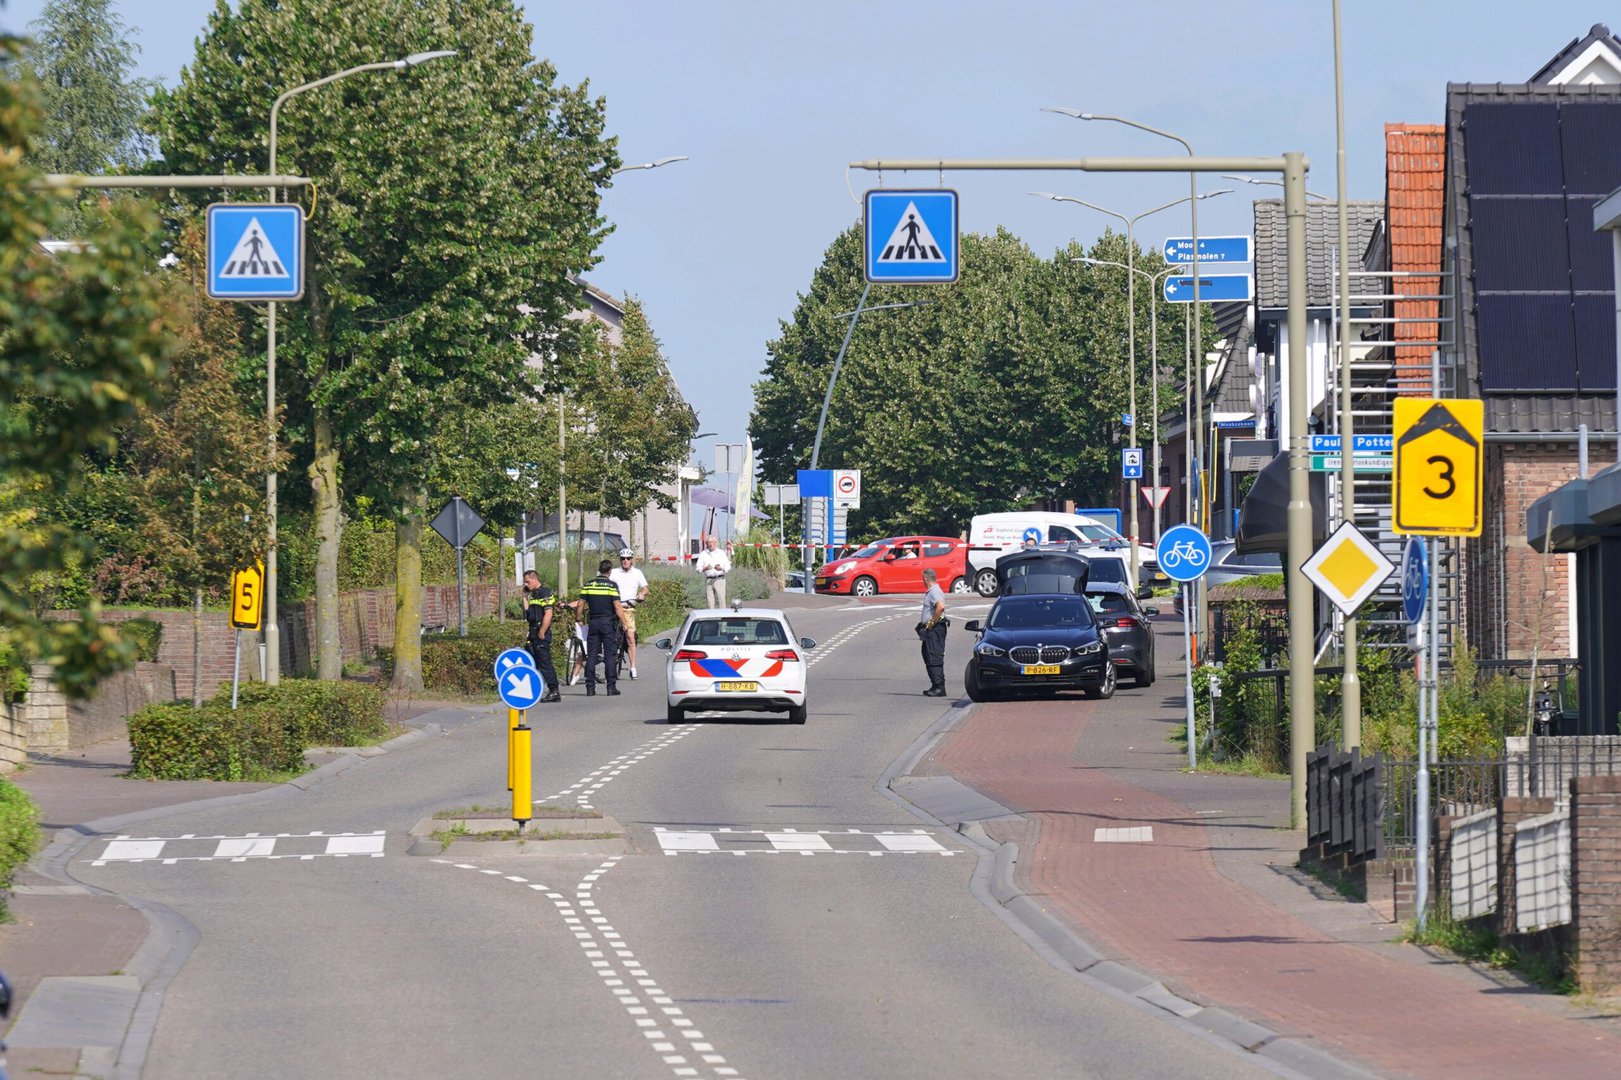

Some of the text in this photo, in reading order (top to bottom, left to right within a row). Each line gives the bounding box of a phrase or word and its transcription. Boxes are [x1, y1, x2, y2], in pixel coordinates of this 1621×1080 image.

[1315, 437, 1341, 446] Paul
[1423, 455, 1456, 500] 3
[241, 583, 253, 611] 5
